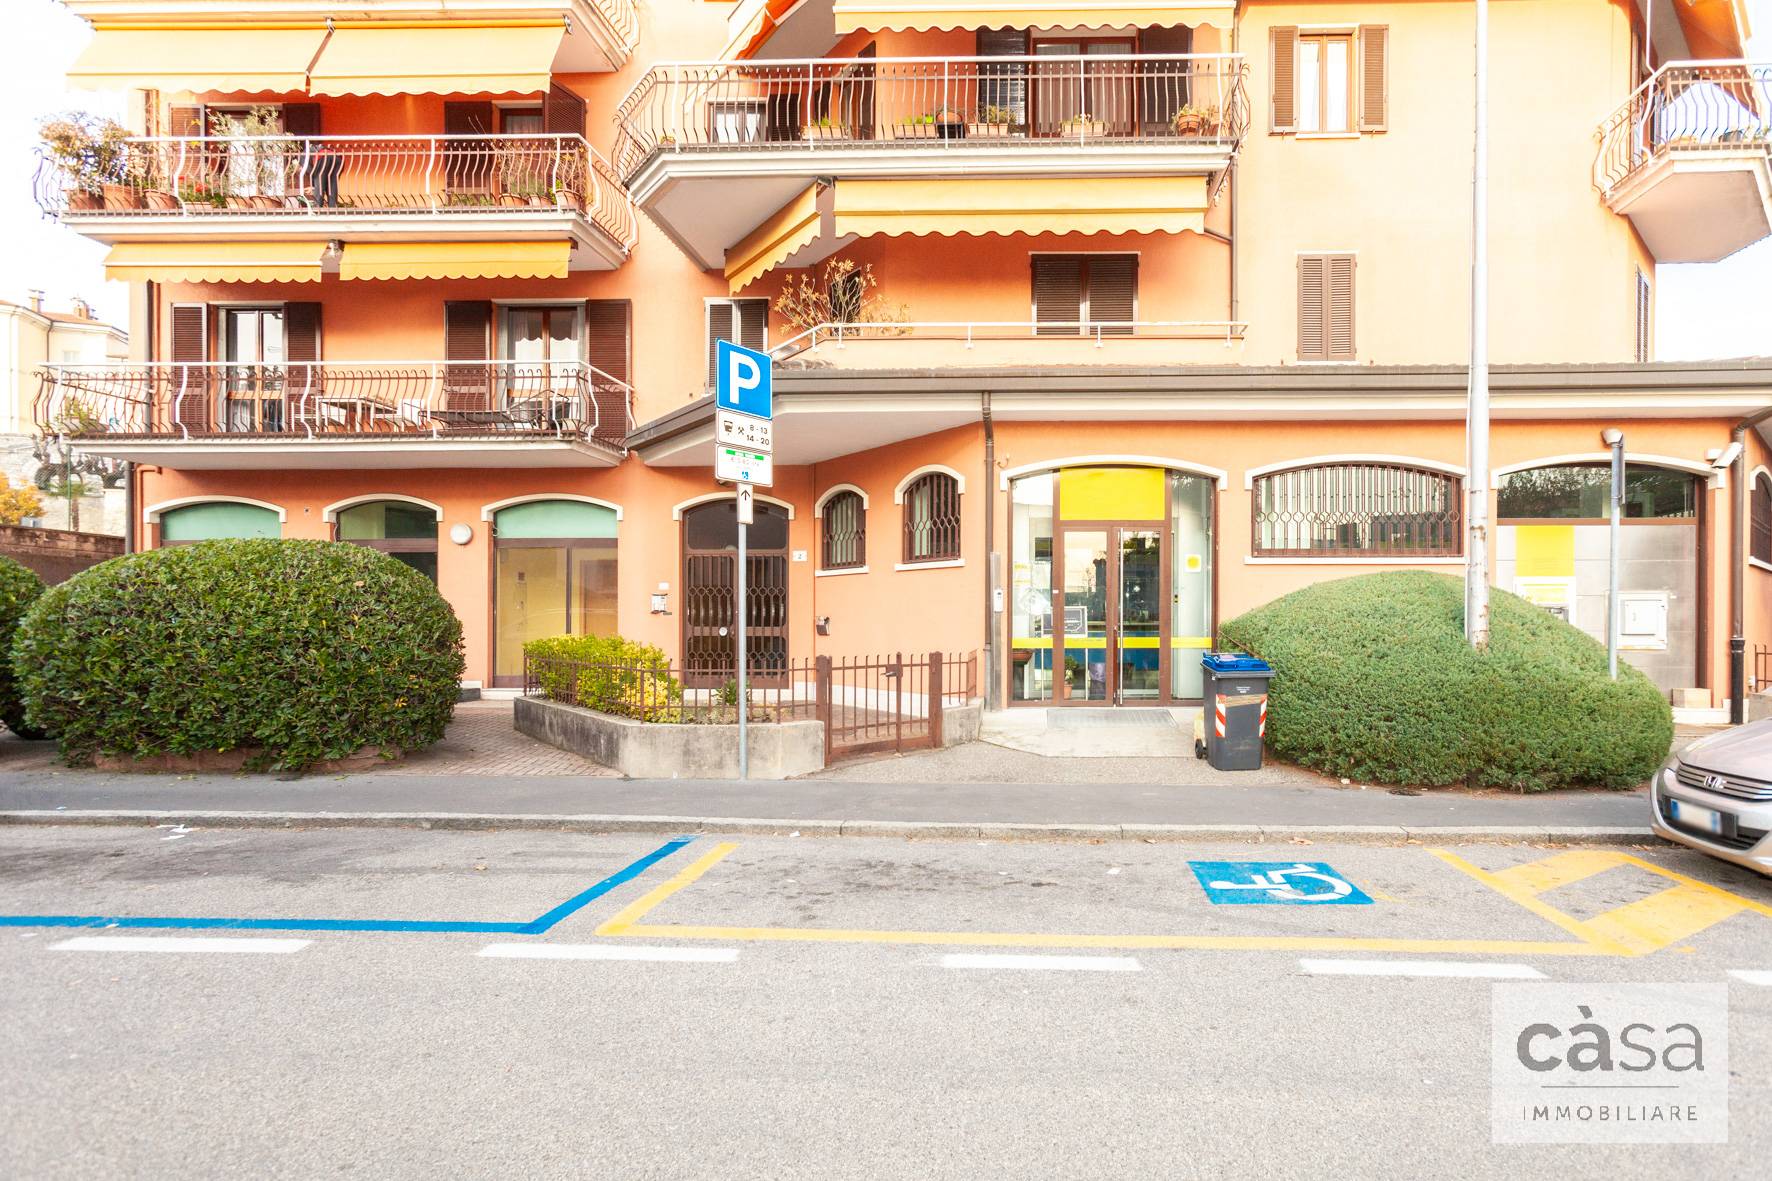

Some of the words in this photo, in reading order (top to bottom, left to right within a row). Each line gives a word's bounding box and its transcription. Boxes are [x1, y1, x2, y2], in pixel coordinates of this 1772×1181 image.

[729, 350, 761, 405] P
[760, 426, 768, 435] 13
[746, 434, 754, 442] 14
[760, 437, 770, 446] 20
